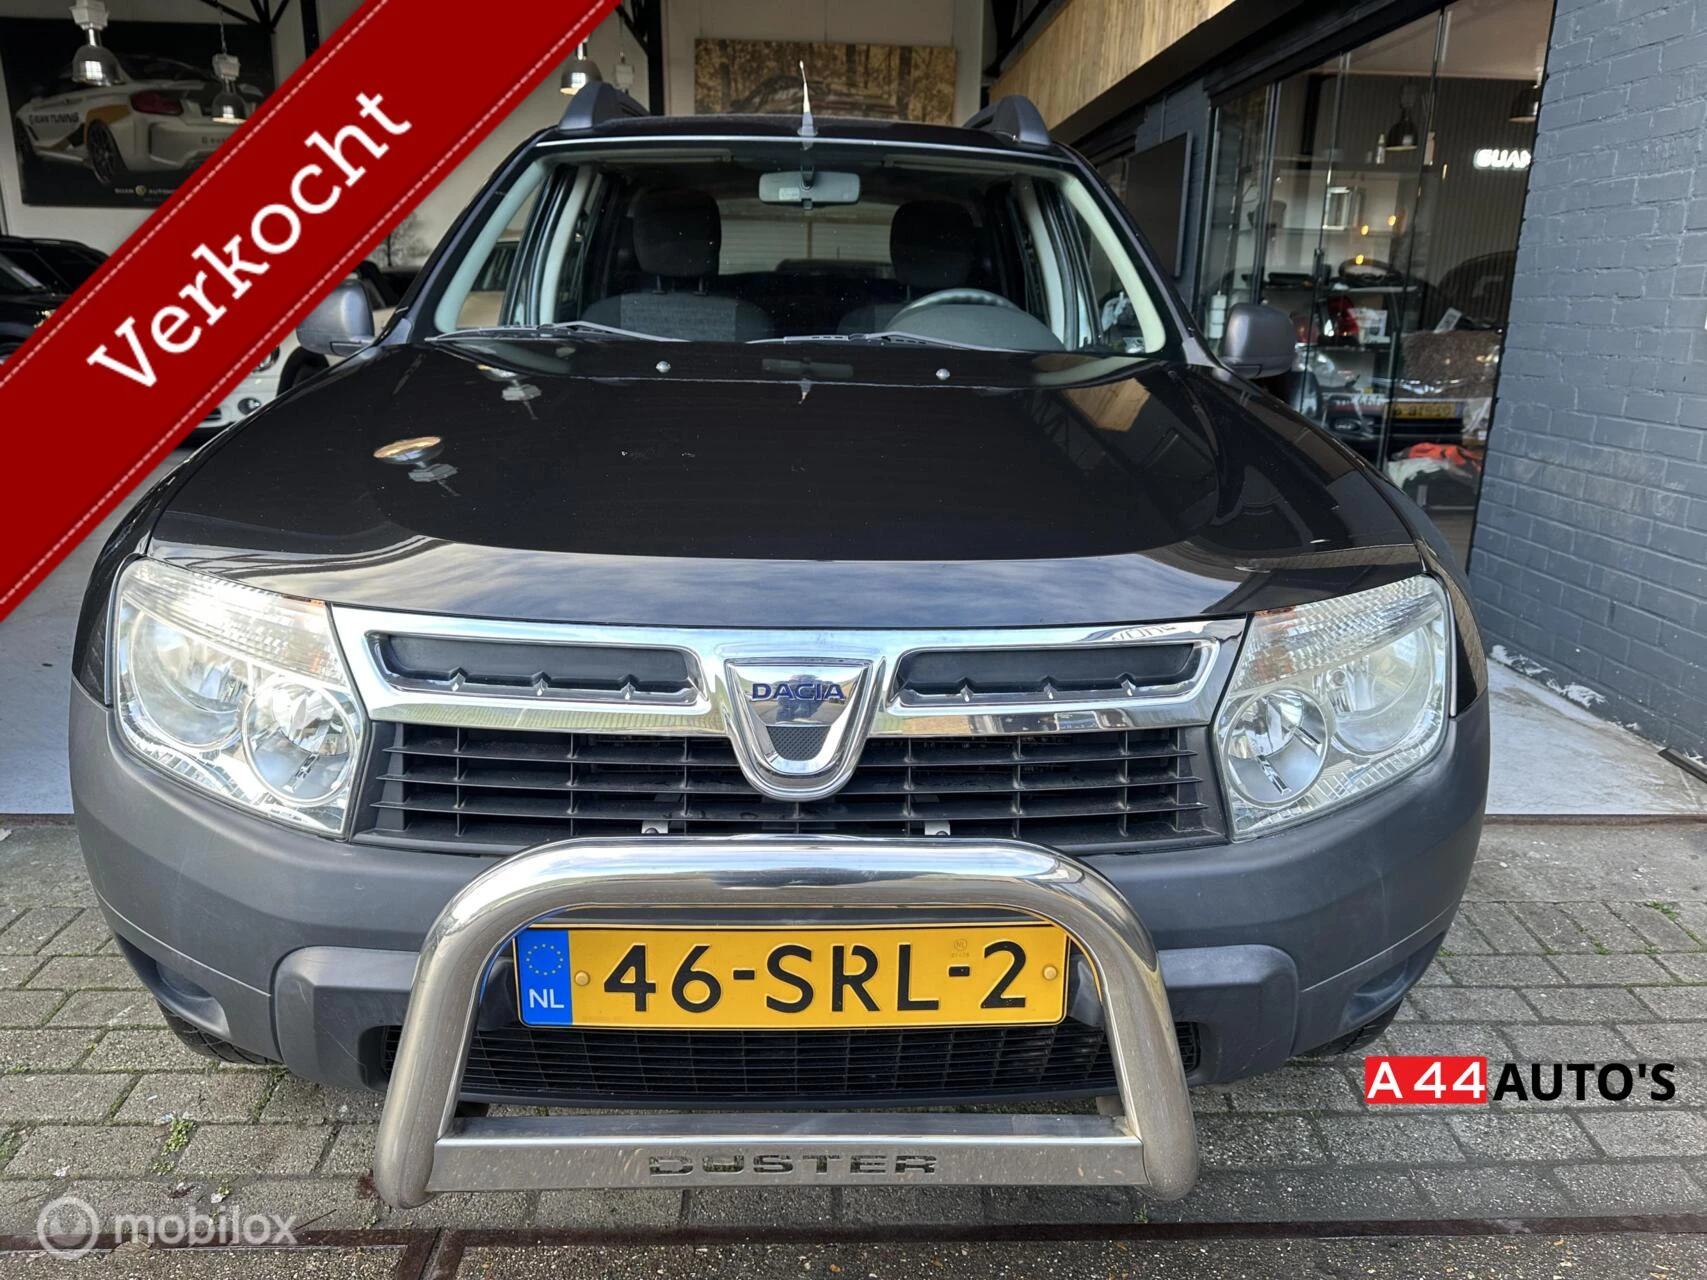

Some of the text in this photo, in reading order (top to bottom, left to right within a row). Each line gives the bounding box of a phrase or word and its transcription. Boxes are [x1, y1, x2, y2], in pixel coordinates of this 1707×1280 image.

[752, 683, 847, 701] DACIA
[603, 940, 1027, 1014] 46-SRL-2
[529, 988, 565, 1009] NL
[649, 1154, 937, 1176] DUSTER
